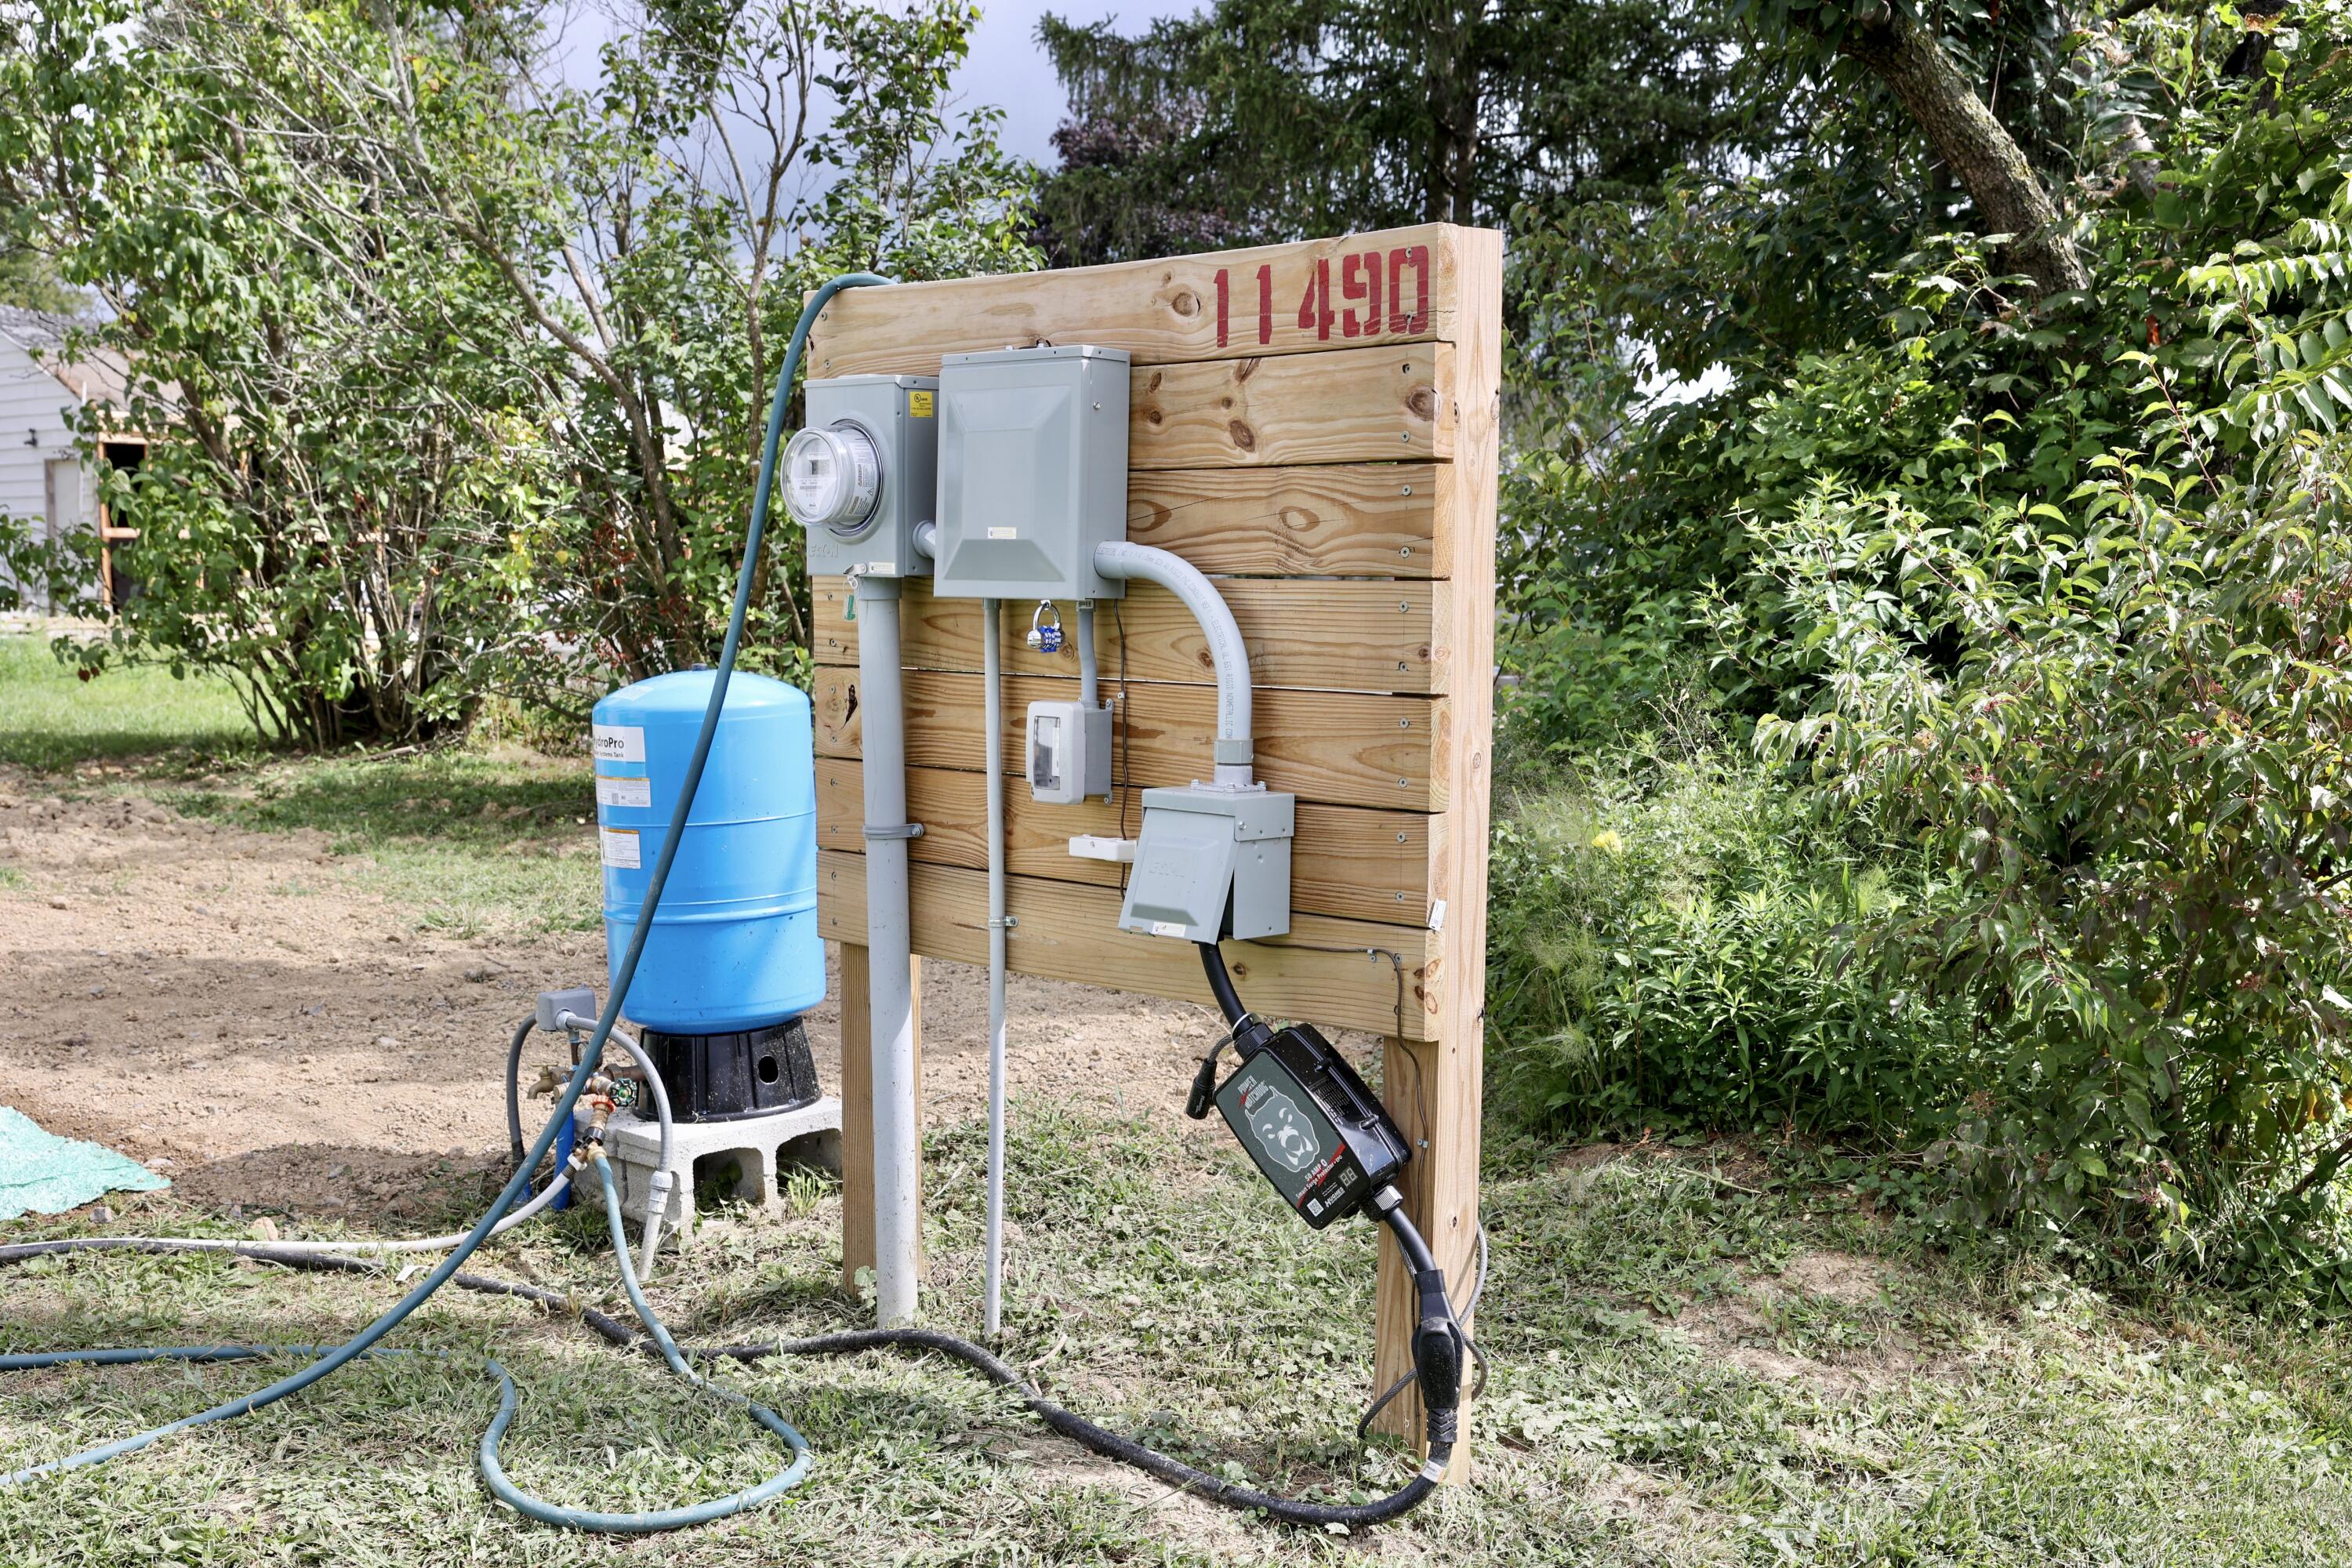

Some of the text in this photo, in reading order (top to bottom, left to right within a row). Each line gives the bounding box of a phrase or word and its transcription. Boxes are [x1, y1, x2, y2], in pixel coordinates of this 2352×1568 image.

[1214, 245, 1428, 347] 11490
[1295, 1187, 1308, 1199] Smart
[1305, 1178, 1319, 1189] Surge
[1316, 1163, 1334, 1179] Protector
[1304, 1163, 1322, 1181] 50 AMP
[1324, 1186, 1345, 1208] HUGHES
